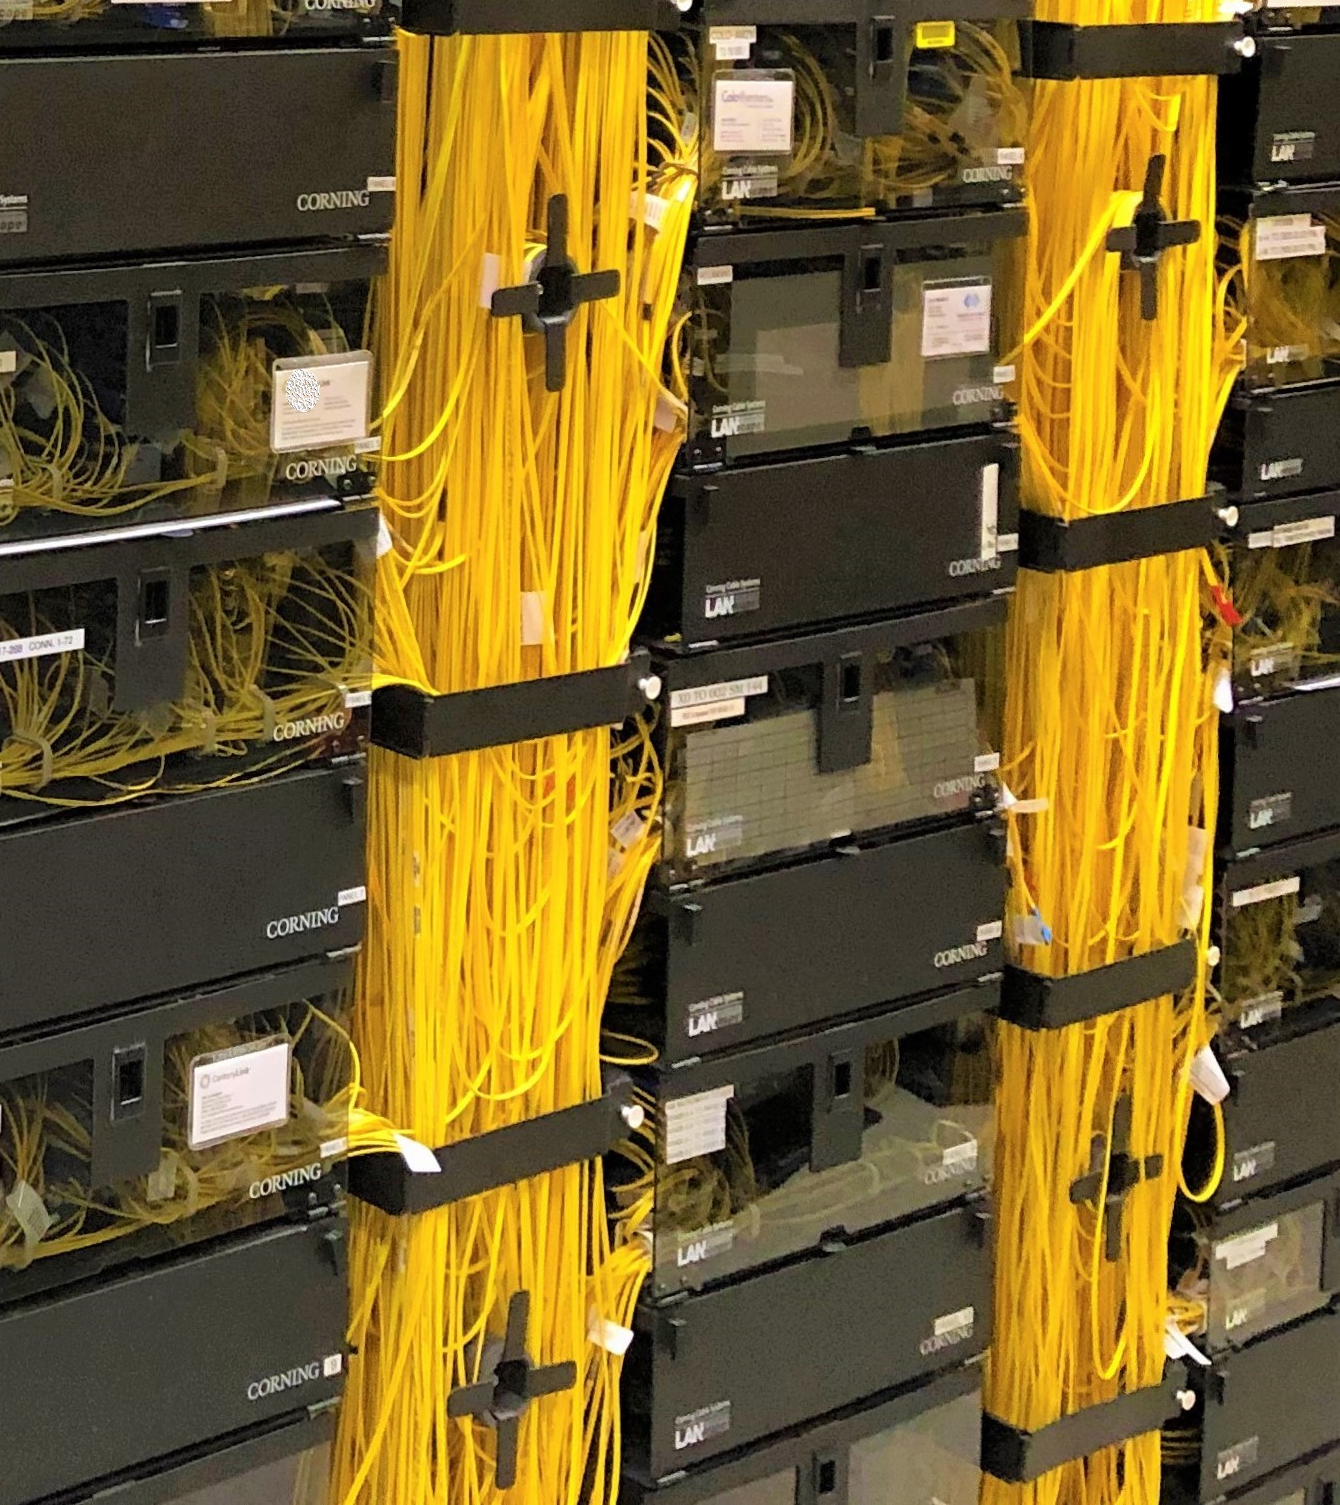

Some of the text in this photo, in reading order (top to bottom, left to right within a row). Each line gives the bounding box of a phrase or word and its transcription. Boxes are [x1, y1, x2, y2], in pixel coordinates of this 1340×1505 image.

[963, 165, 1013, 183] CORNING
[0, 194, 28, 206] Systems
[296, 189, 371, 212] CORNING
[952, 385, 1004, 406] CORNING
[285, 455, 357, 481] CORNING
[272, 712, 345, 743] CORNING
[933, 774, 986, 798] CORNING
[266, 906, 339, 940] CORNING
[934, 940, 988, 968] CORNING
[248, 1162, 321, 1199] CORNING
[247, 1363, 320, 1400] CORNING
